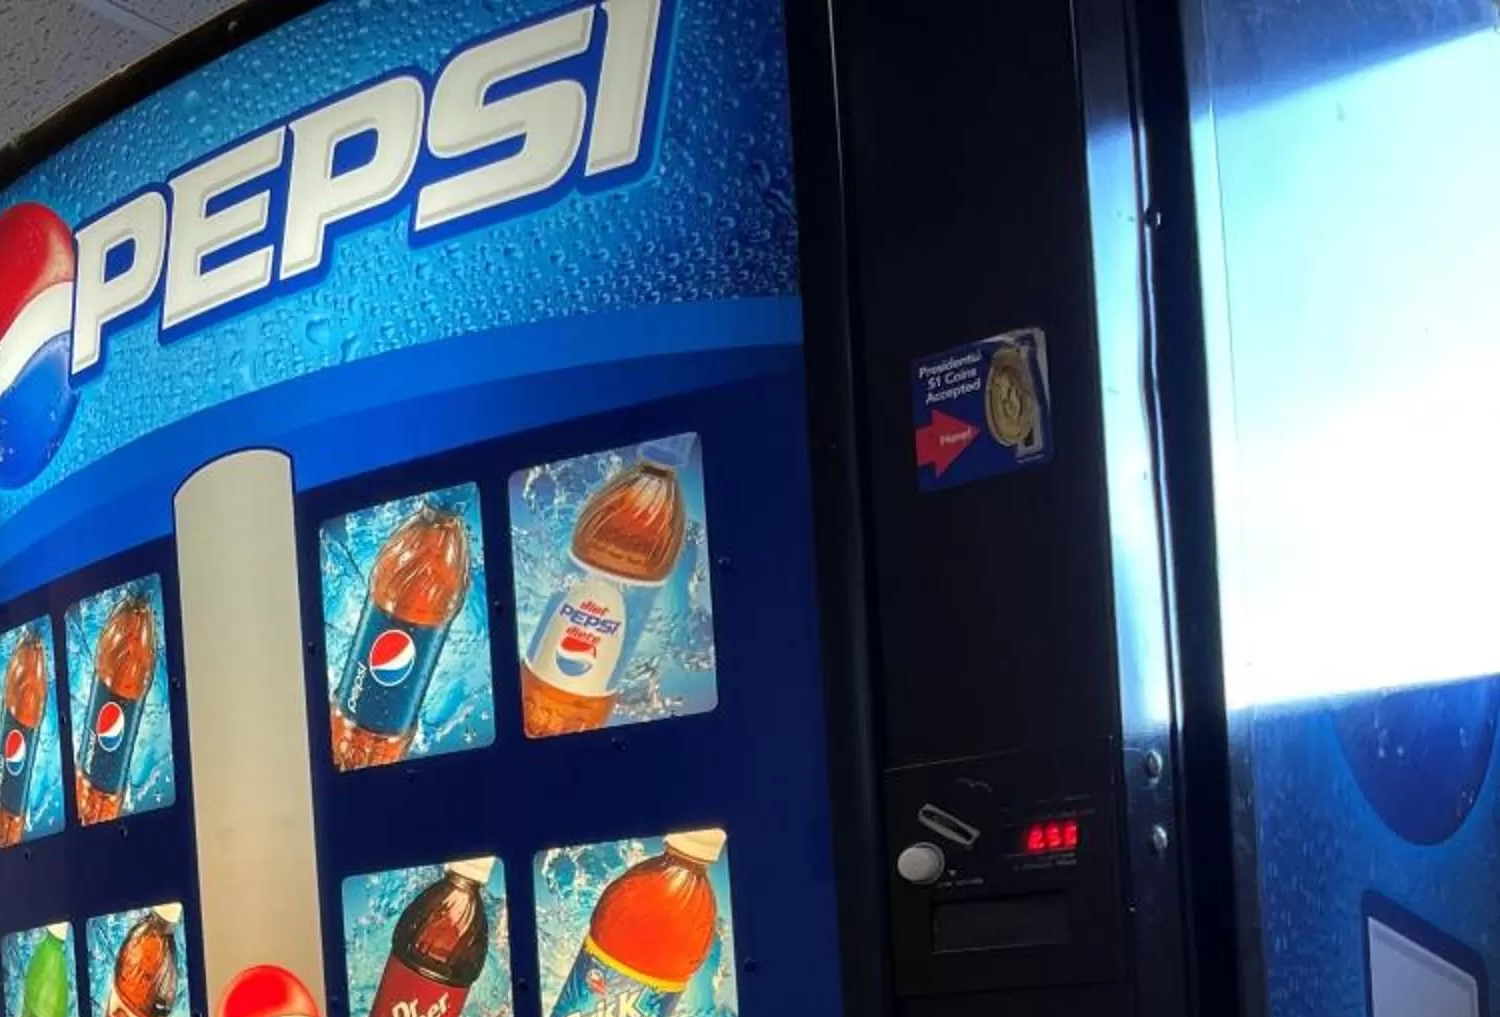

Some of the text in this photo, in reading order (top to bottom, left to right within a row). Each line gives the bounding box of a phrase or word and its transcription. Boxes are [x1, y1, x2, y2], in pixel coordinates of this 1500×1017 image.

[71, 0, 661, 375] PEPSI
[925, 377, 981, 405] Accepted
[944, 367, 977, 385] Coins
[560, 603, 621, 635] PEPSI
